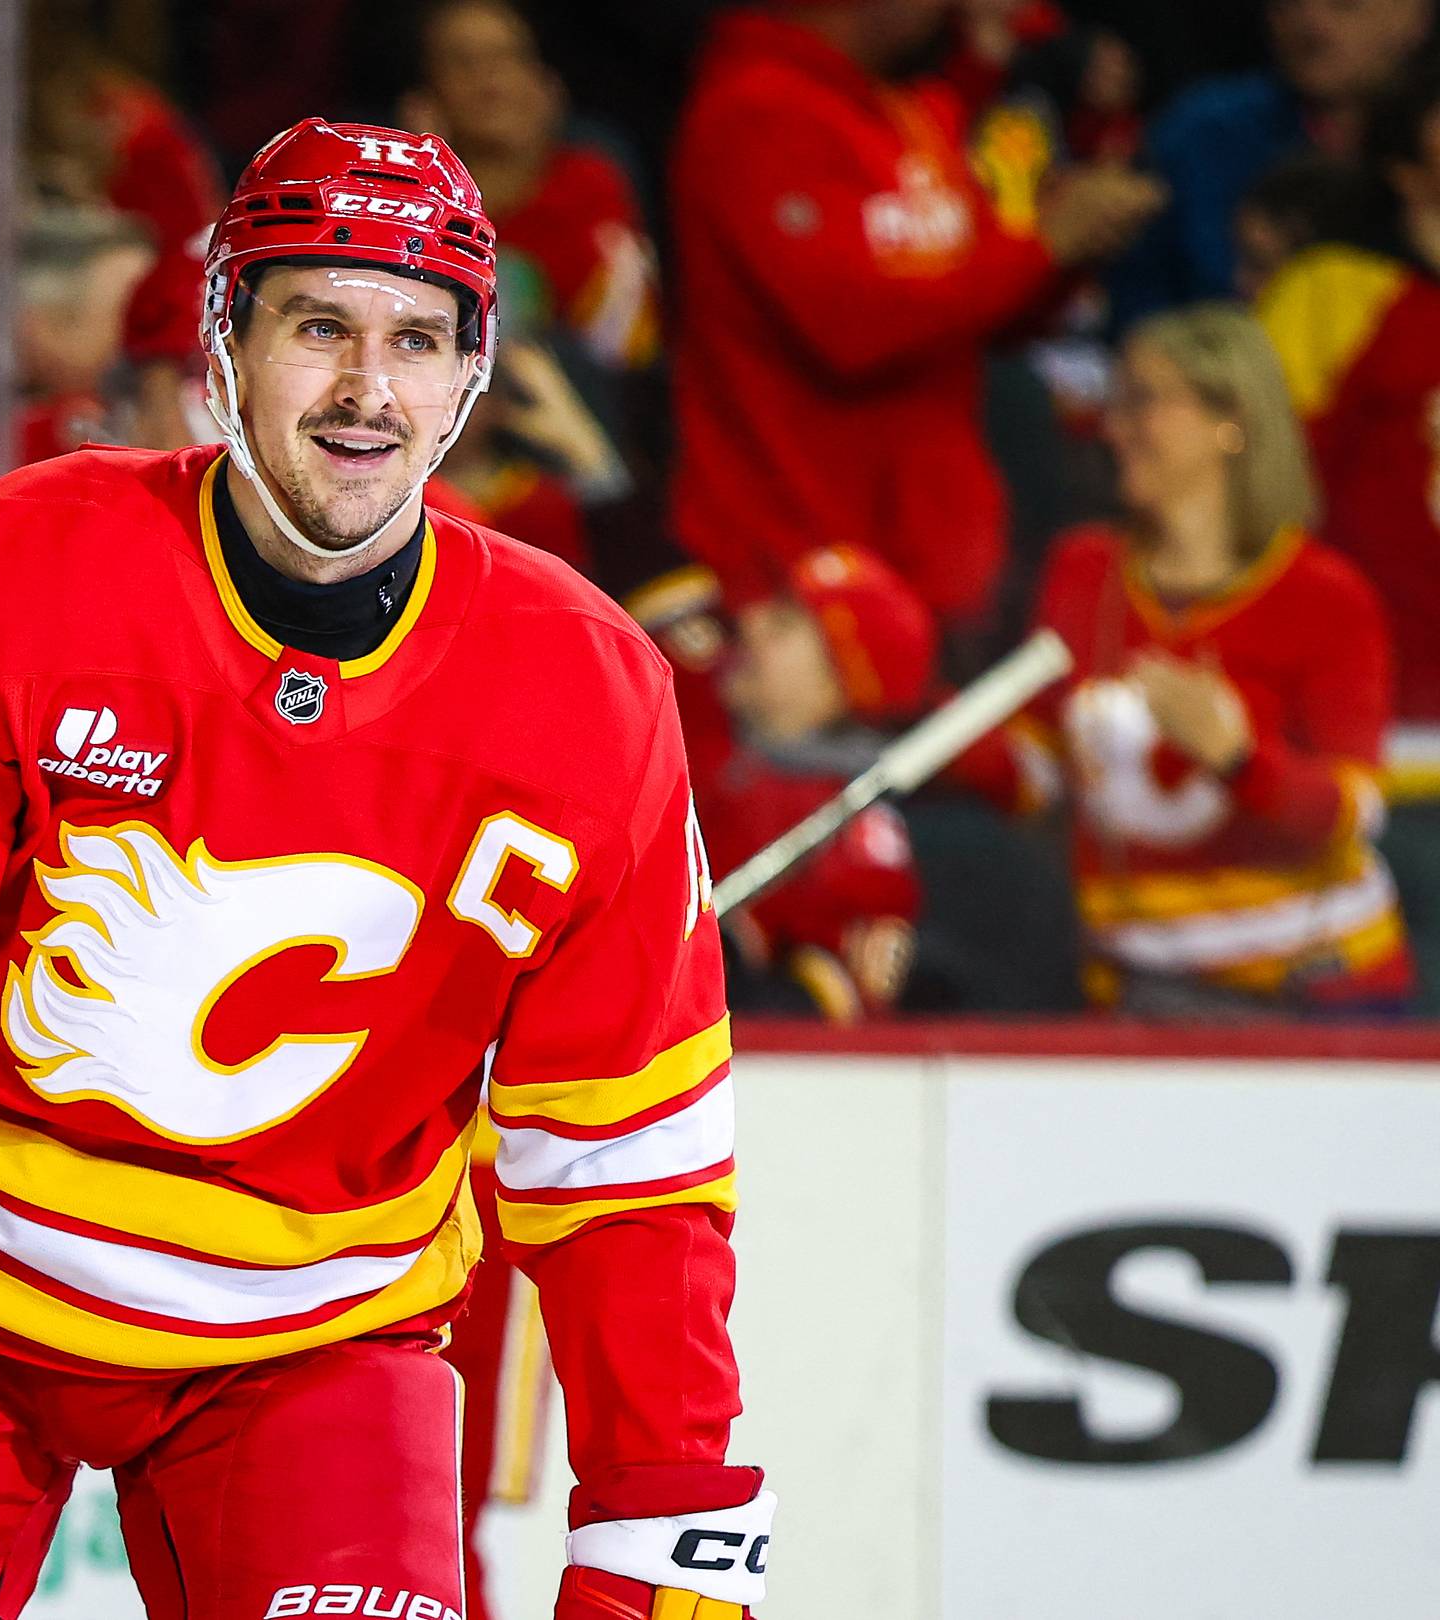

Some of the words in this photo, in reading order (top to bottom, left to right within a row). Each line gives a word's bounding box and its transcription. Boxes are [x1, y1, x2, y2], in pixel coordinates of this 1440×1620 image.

[331, 192, 435, 222] CCM
[283, 687, 318, 710] NHL
[83, 744, 169, 777] play
[36, 757, 164, 798] alberta
[446, 809, 580, 959] C
